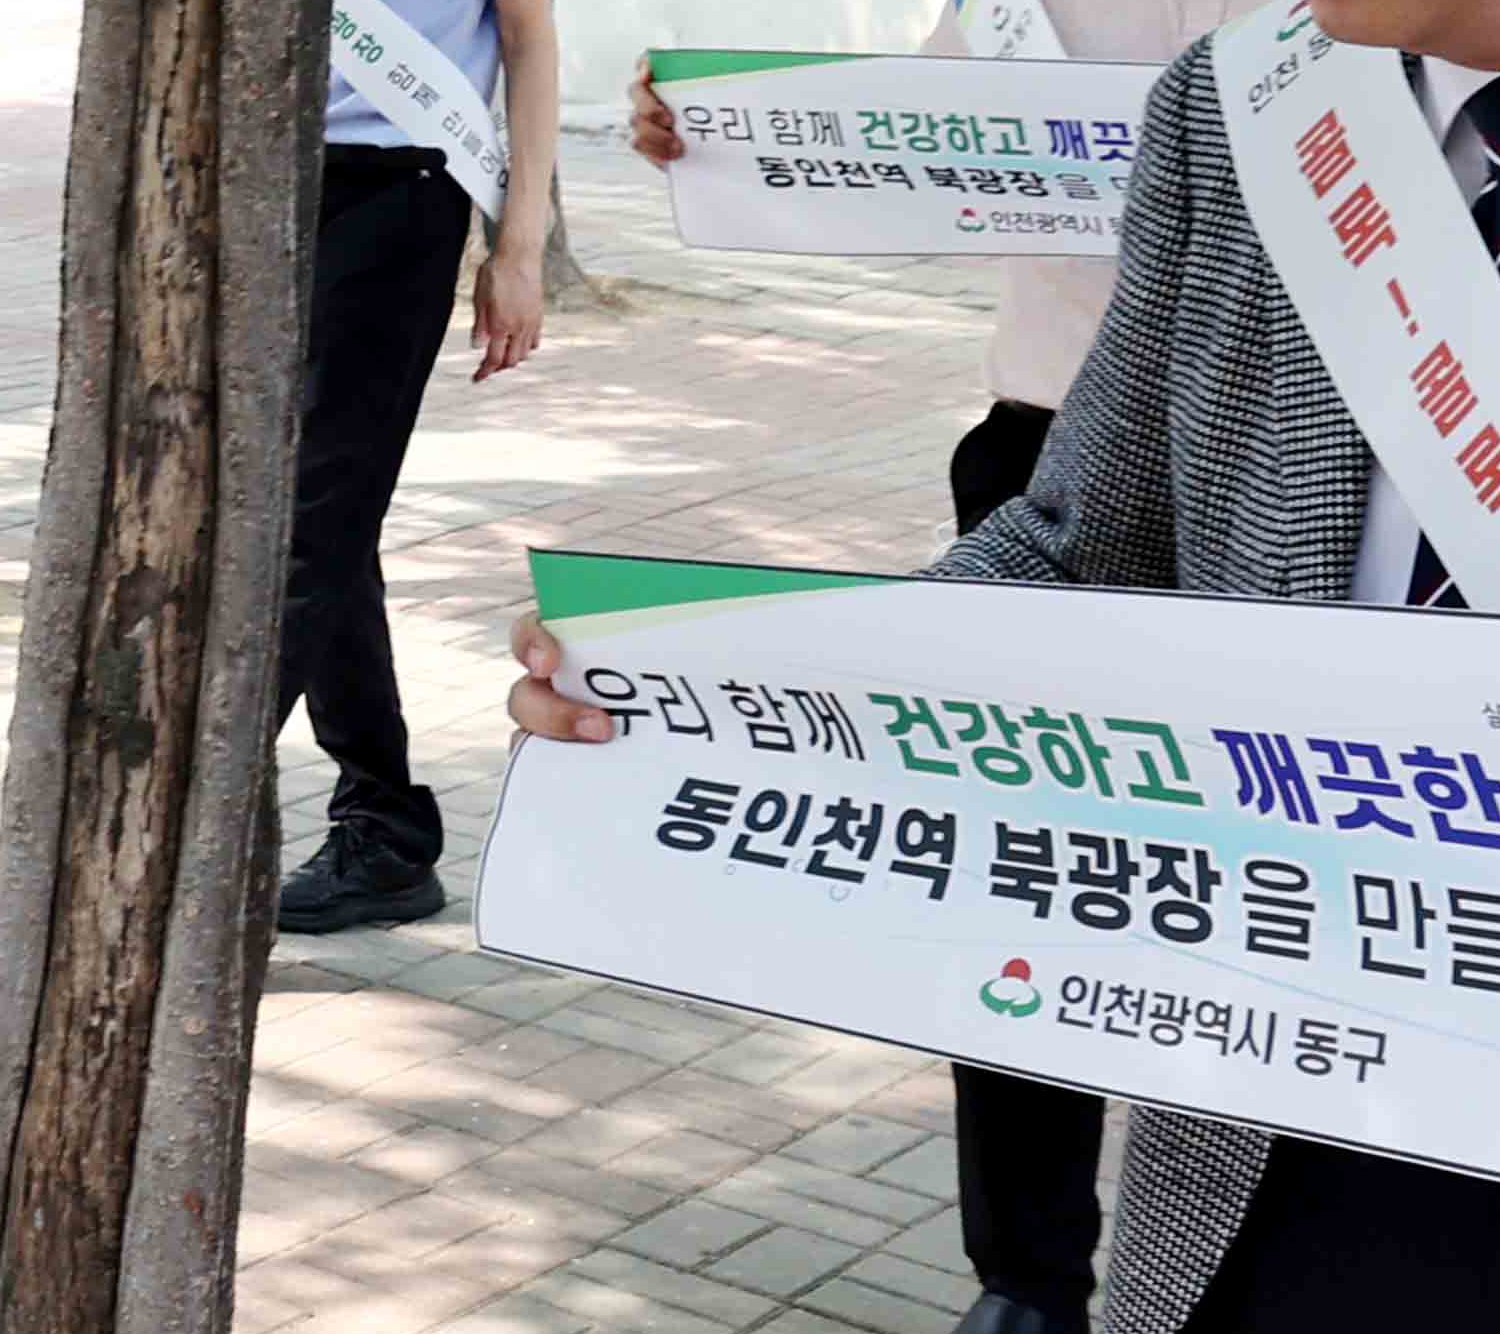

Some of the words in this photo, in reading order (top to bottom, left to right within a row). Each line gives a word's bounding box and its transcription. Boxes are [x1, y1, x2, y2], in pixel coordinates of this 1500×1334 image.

[1248, 52, 1302, 113] 인천
[684, 104, 750, 145] 우리
[770, 108, 844, 149] 함께
[855, 111, 1031, 155] 건강하고
[1045, 118, 1137, 161] 깨끗
[756, 157, 914, 192] 동인천역
[923, 163, 1099, 200] 북광장을
[988, 210, 1103, 235] 인천광역시
[583, 661, 710, 743] 우리
[723, 674, 860, 766] 함께
[864, 684, 1198, 808] 건강하고
[655, 775, 956, 897] 동인천역
[987, 807, 1314, 961] 북광장을
[1056, 968, 1279, 1064] 인천광역시
[1292, 1009, 1388, 1080] 동구
